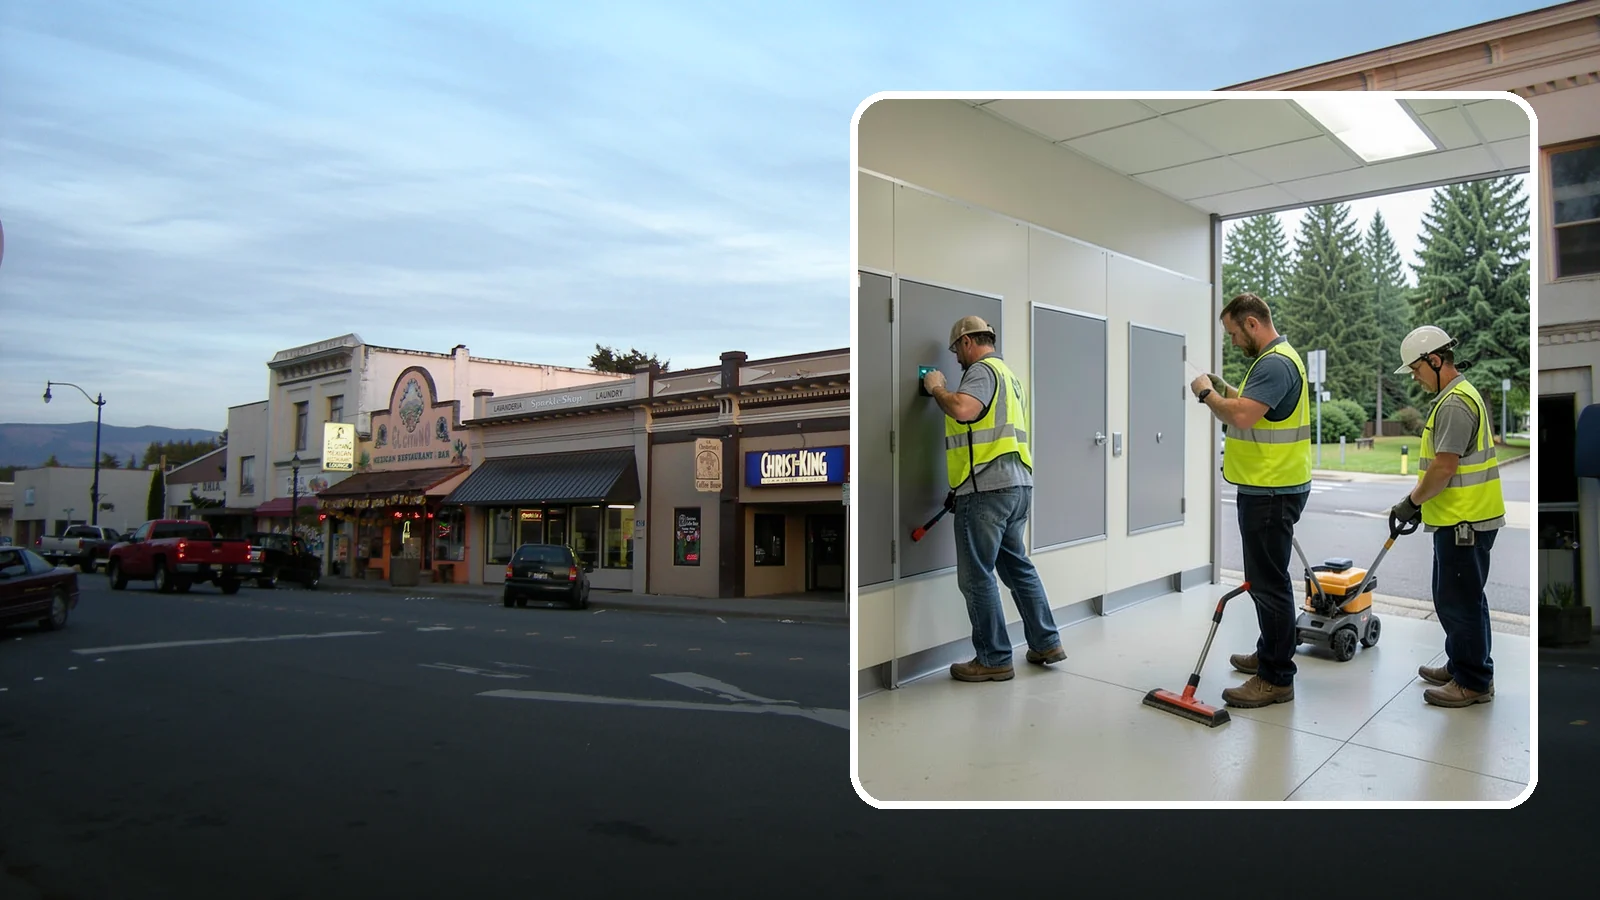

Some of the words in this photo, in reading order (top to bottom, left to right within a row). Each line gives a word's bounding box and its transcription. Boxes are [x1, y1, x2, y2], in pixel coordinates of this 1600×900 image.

[595, 389, 623, 400] LAUNDRY
[493, 402, 522, 413] LAVANDERIA
[531, 399, 559, 409] Sparkle
[561, 394, 583, 405] Shop
[374, 455, 396, 463] MEXICAN
[397, 451, 433, 462] RESTAURANT
[438, 450, 450, 458] BAR
[761, 452, 798, 478] CHRIST
[799, 450, 827, 476] KING
[696, 481, 709, 489] Coffee
[709, 481, 722, 489] House
